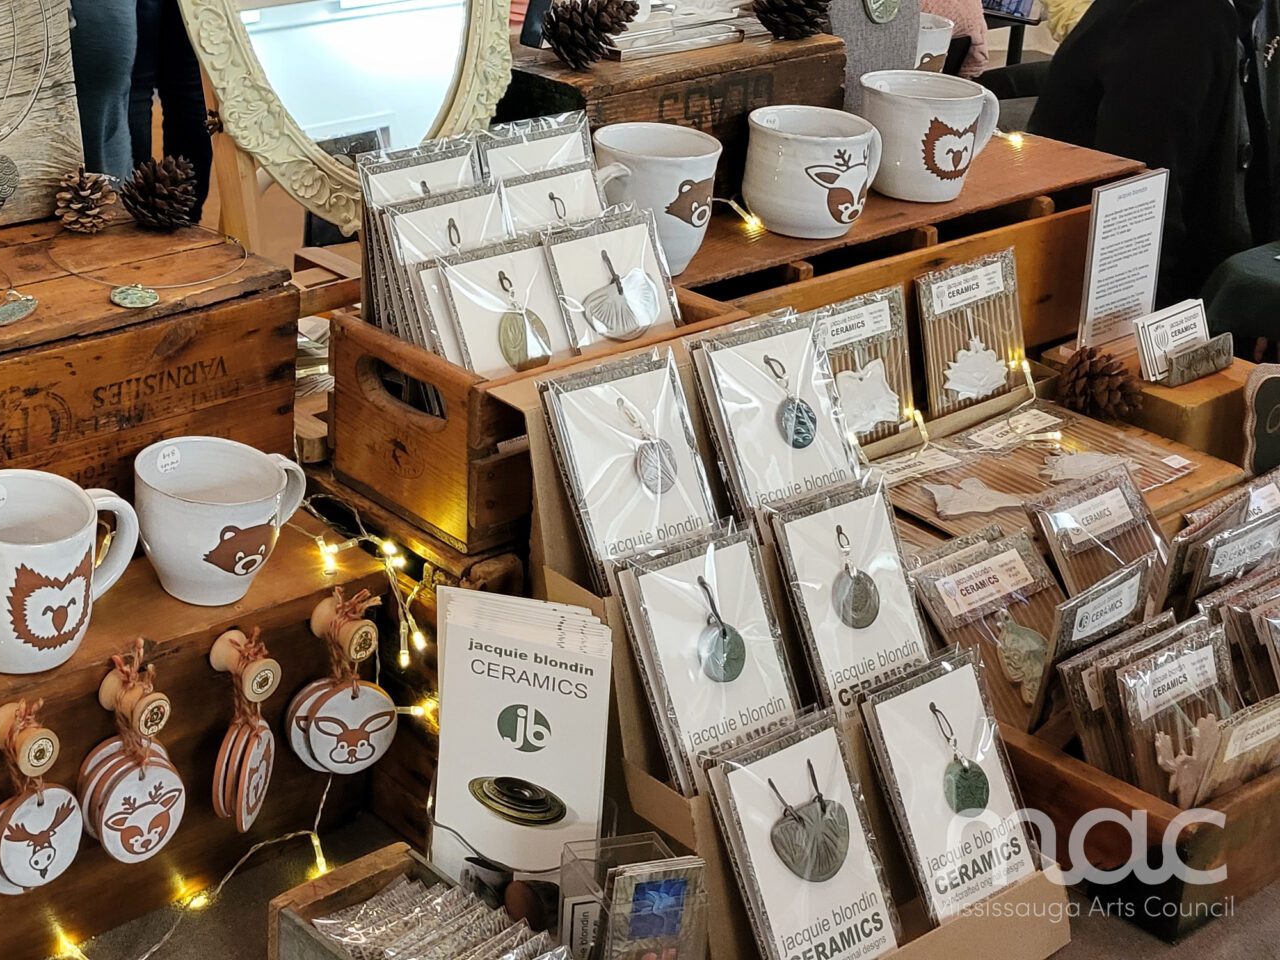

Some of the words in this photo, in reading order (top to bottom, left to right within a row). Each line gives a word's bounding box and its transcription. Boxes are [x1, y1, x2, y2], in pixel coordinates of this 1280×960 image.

[947, 282, 980, 300] CERAMICS
[830, 319, 866, 337] CERAMICS
[1170, 321, 1198, 338] CERAMICS
[755, 480, 802, 509] jacquie
[804, 467, 847, 492] blondin
[604, 529, 655, 559] jacquie
[656, 514, 705, 541] blondin
[1081, 506, 1113, 527] CERAMICS
[960, 574, 1000, 598] CERAMICS
[1091, 598, 1124, 624] CERAMICS
[468, 637, 529, 661] jacquie
[533, 652, 595, 677] blondin
[829, 656, 877, 690] jacquie
[877, 638, 921, 668] blondin
[471, 658, 588, 700] CERAMICS
[1152, 673, 1188, 699] CERAMICS
[687, 714, 738, 752] jacquie
[738, 695, 787, 728] blondin
[926, 845, 972, 878] jacquie
[972, 817, 1017, 850] blondin
[934, 836, 1022, 895] CERAMICS
[581, 911, 590, 946] blondin
[781, 917, 831, 958] jacquie
[831, 891, 878, 927] blondin
[790, 911, 884, 960] ERAMICS
[862, 935, 887, 955] designs
